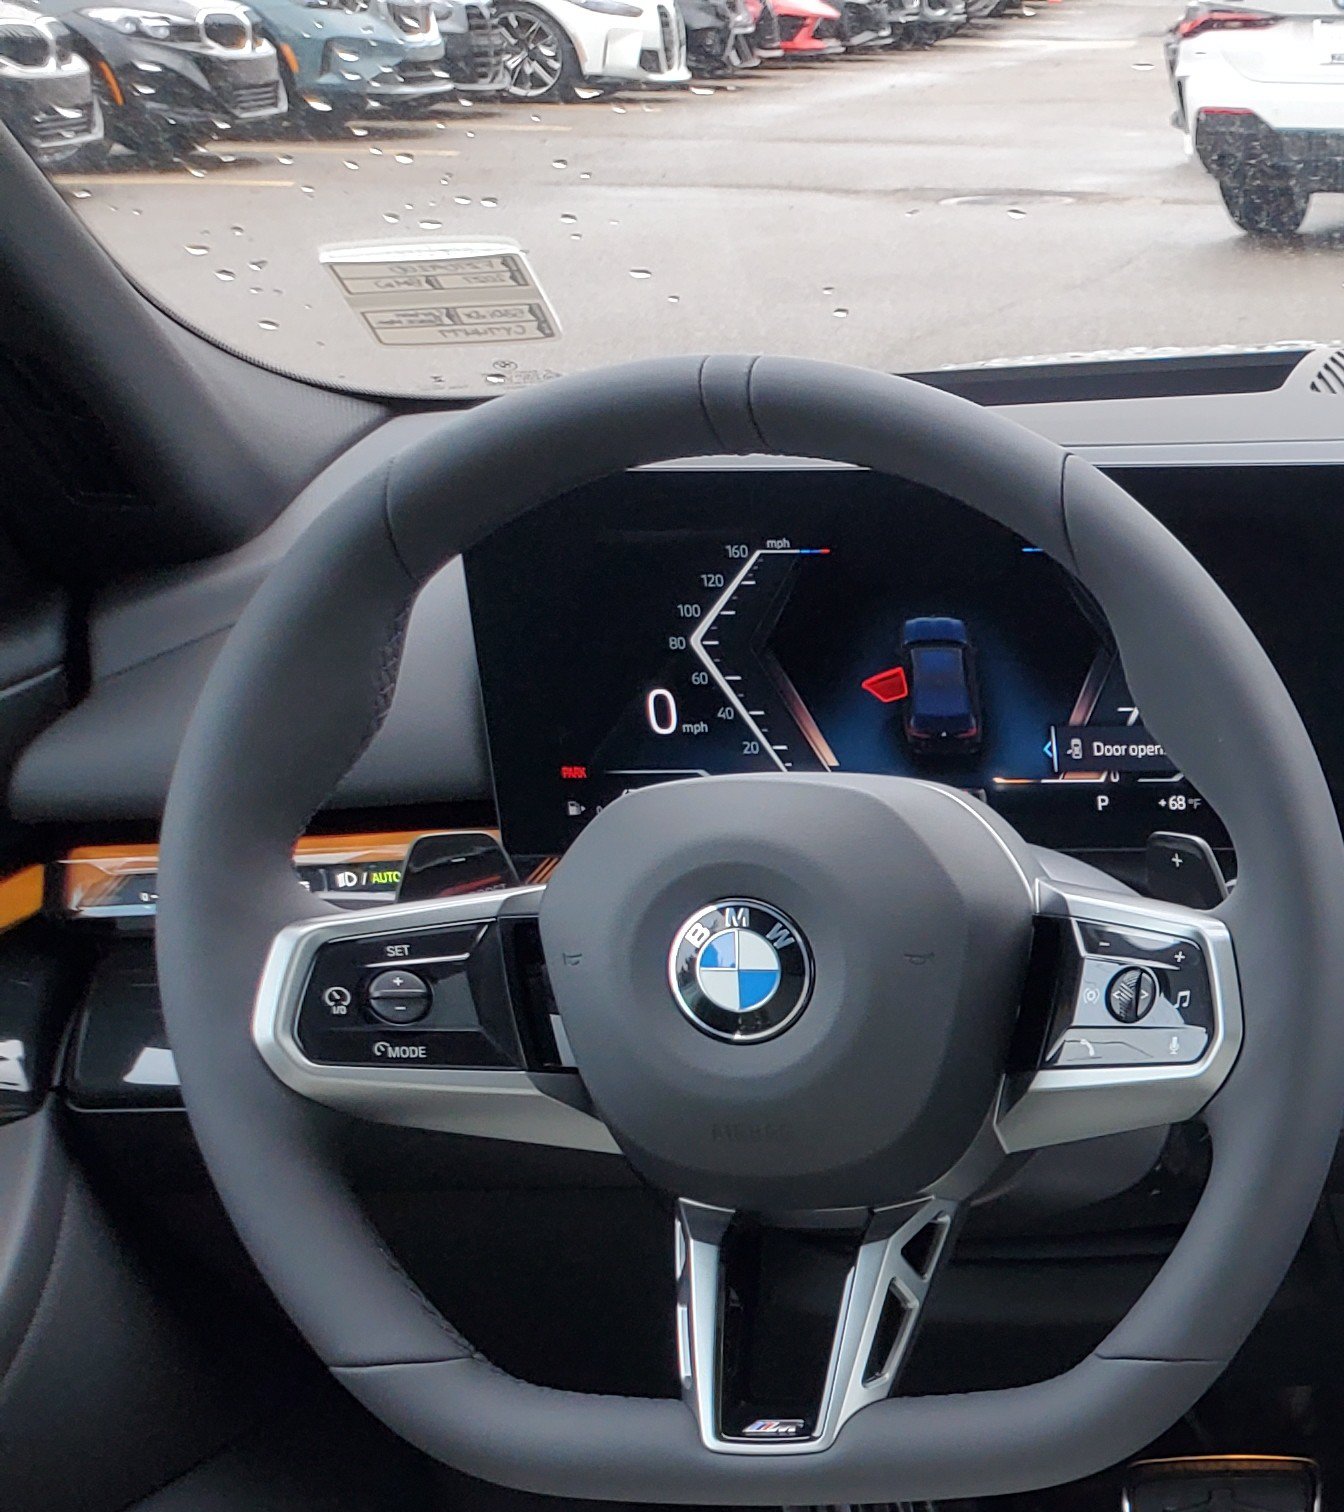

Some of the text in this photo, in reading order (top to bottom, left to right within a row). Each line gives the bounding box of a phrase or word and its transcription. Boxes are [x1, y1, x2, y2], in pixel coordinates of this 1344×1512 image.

[766, 537, 790, 549] mph
[725, 544, 748, 558] 160
[701, 574, 724, 588] 120
[677, 604, 701, 618] 100
[669, 636, 686, 650] 80
[692, 671, 708, 685] 60
[647, 688, 678, 735] 0
[717, 707, 734, 720] 40
[682, 721, 708, 734] mph
[742, 741, 759, 754] 20
[1093, 741, 1125, 756] Door
[561, 765, 587, 779] PARK
[1096, 795, 1109, 811] P
[685, 907, 796, 950] BMW
[386, 944, 410, 957] SET
[387, 1046, 427, 1059] MODE
